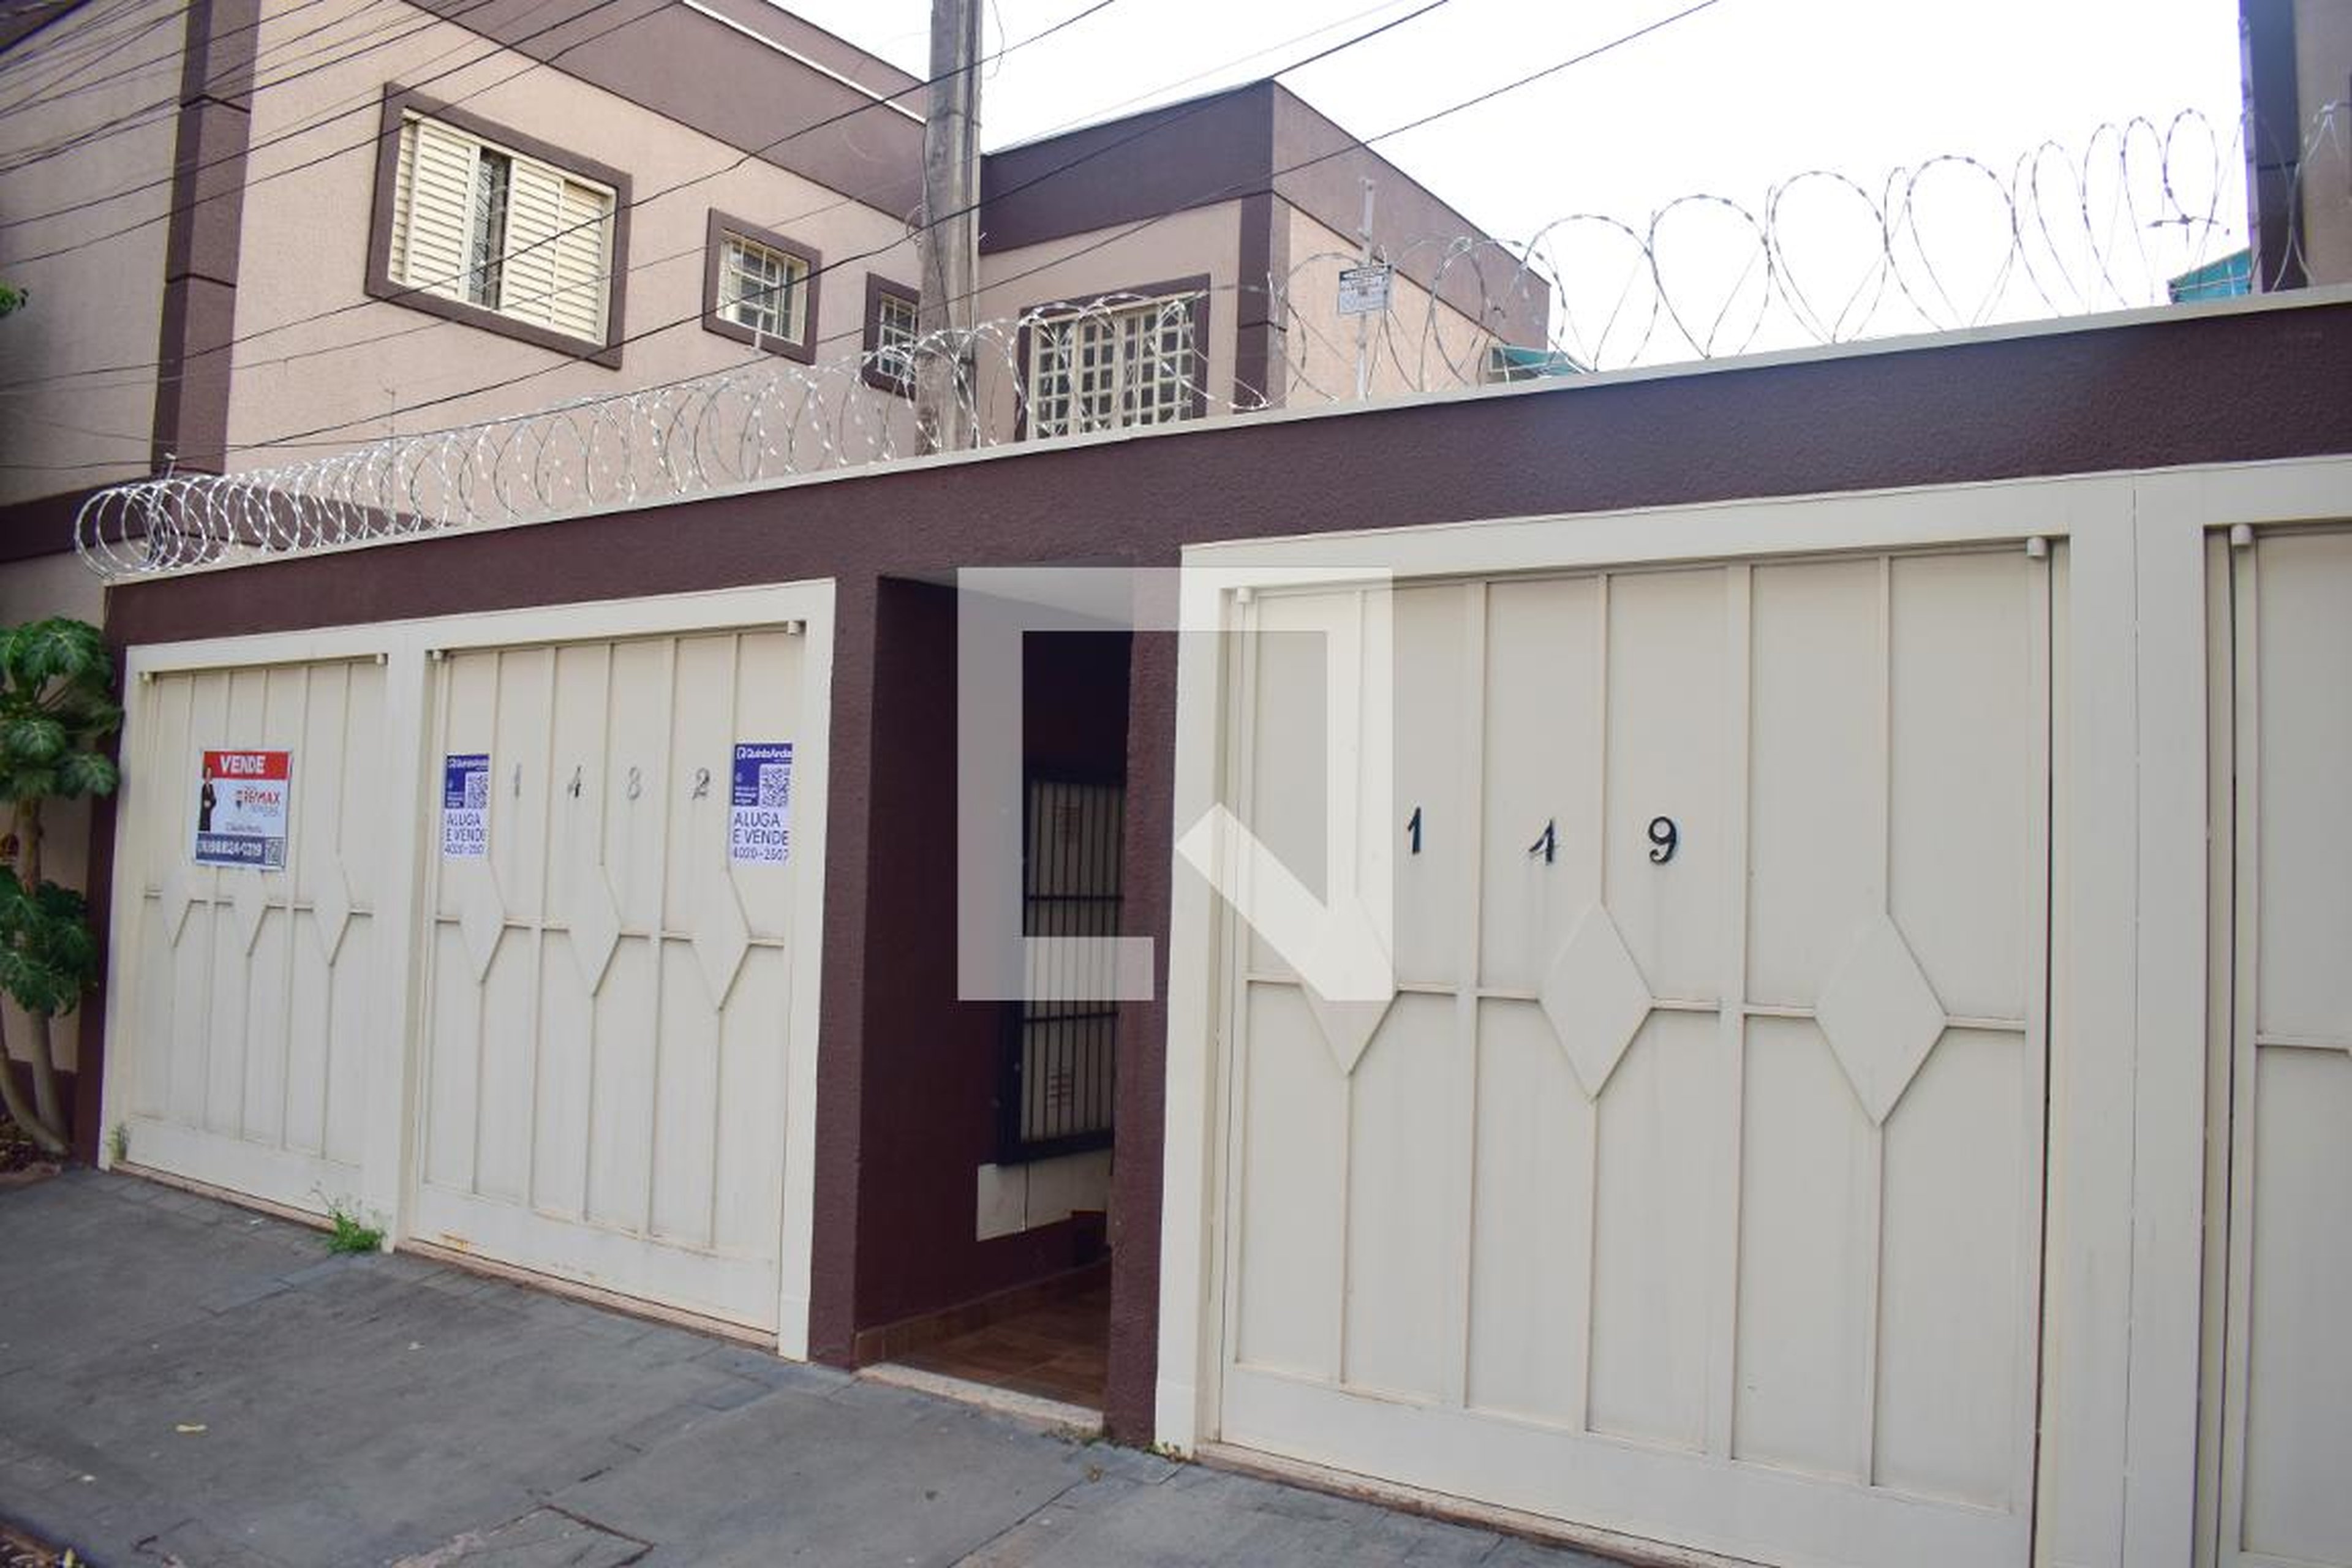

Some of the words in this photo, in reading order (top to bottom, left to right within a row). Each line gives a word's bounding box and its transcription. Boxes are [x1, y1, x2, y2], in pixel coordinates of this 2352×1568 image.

[220, 755, 266, 774] VENDE
[735, 812, 780, 827] ALUGA
[744, 829, 789, 845] VENDE
